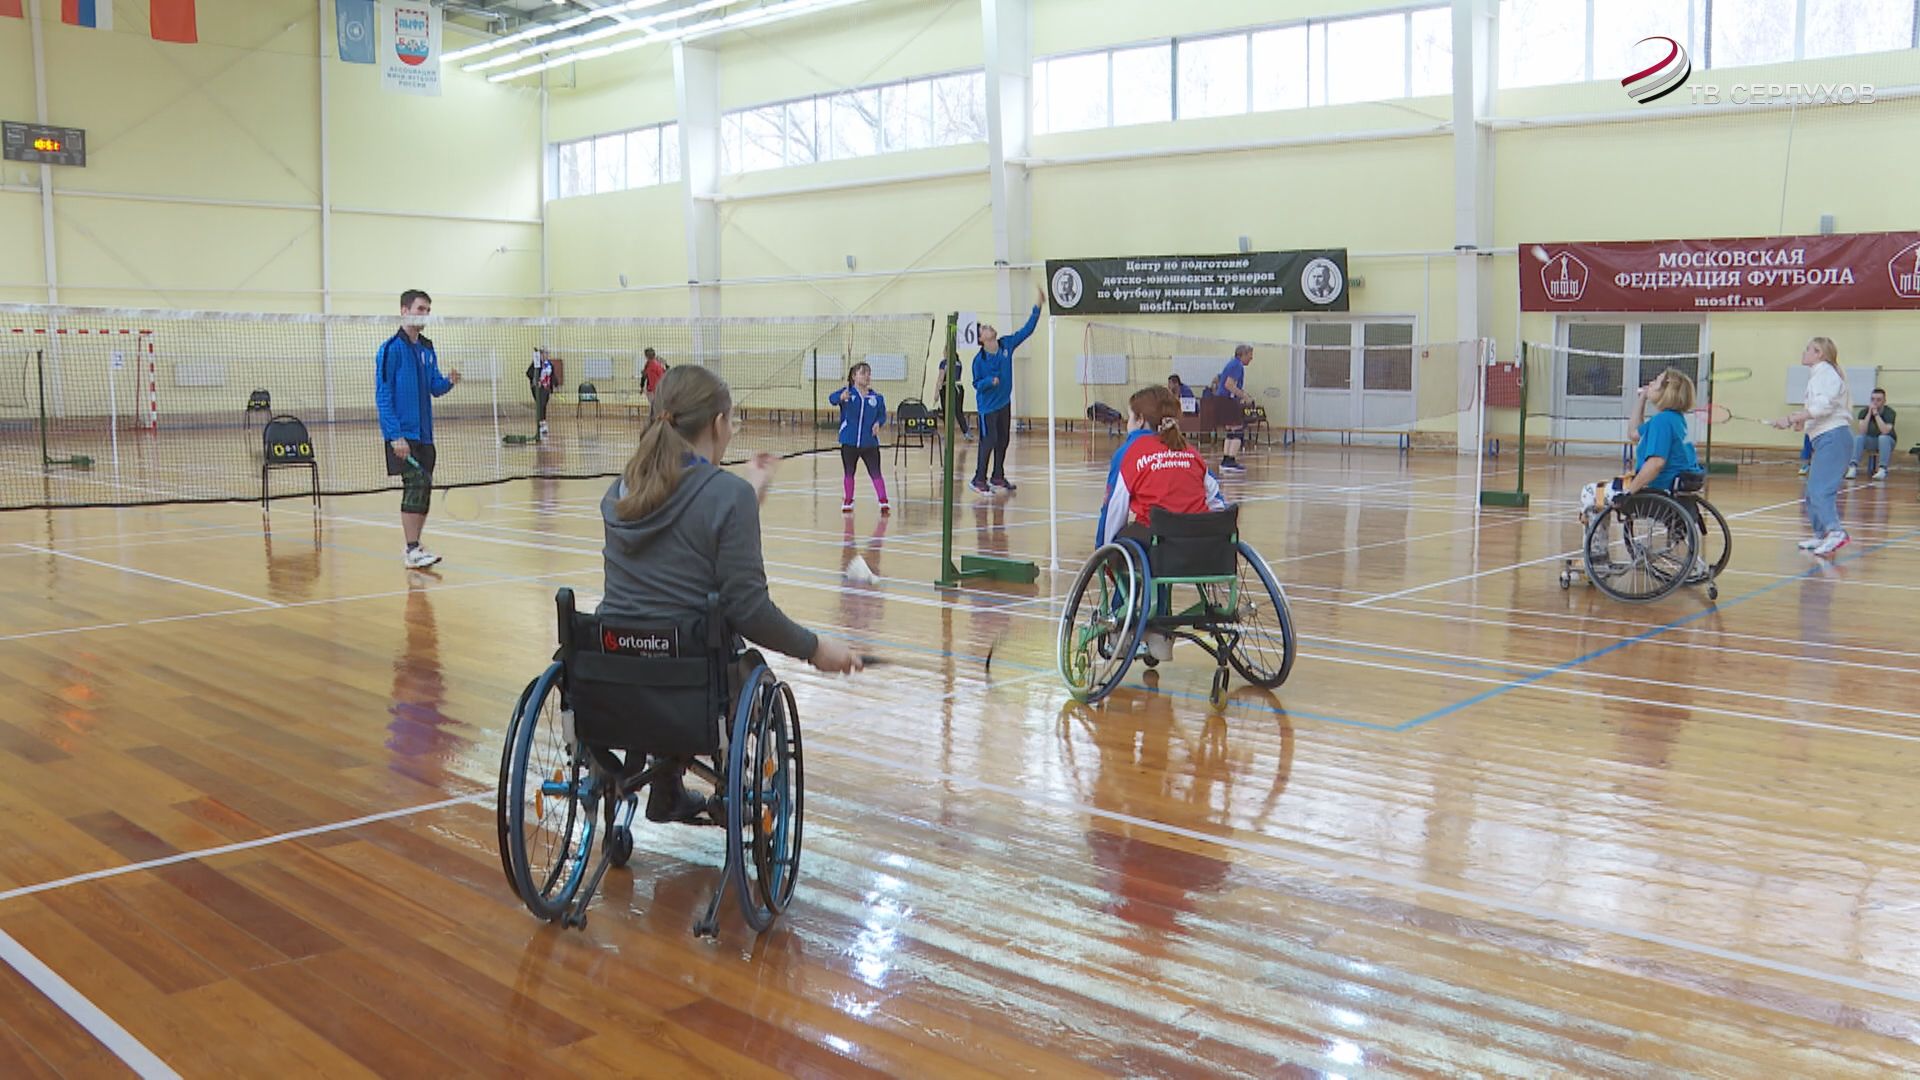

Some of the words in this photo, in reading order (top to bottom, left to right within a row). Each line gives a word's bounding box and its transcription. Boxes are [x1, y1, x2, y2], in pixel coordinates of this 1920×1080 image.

[1659, 248, 1805, 268] МОСКОВСКАЯ
[1126, 260, 1161, 272] Центр
[1163, 261, 1178, 270] по
[1181, 259, 1250, 271] подготовке
[1103, 274, 1215, 286] детско-юношеских
[1217, 273, 1275, 285] тренеров
[1614, 270, 1740, 290] ФЕДЕРАЦИЯ
[1747, 268, 1855, 287] ФУТБОЛА
[1097, 289, 1111, 298] по
[1113, 287, 1161, 300] футболу
[1164, 288, 1200, 298] имени
[1204, 286, 1228, 297] К.И.
[1231, 286, 1283, 297] Бескова
[1139, 300, 1236, 313] mosff.ru/beskov
[1695, 294, 1765, 307] mosff.ru
[964, 321, 975, 344] 6
[618, 634, 669, 651] ortonica
